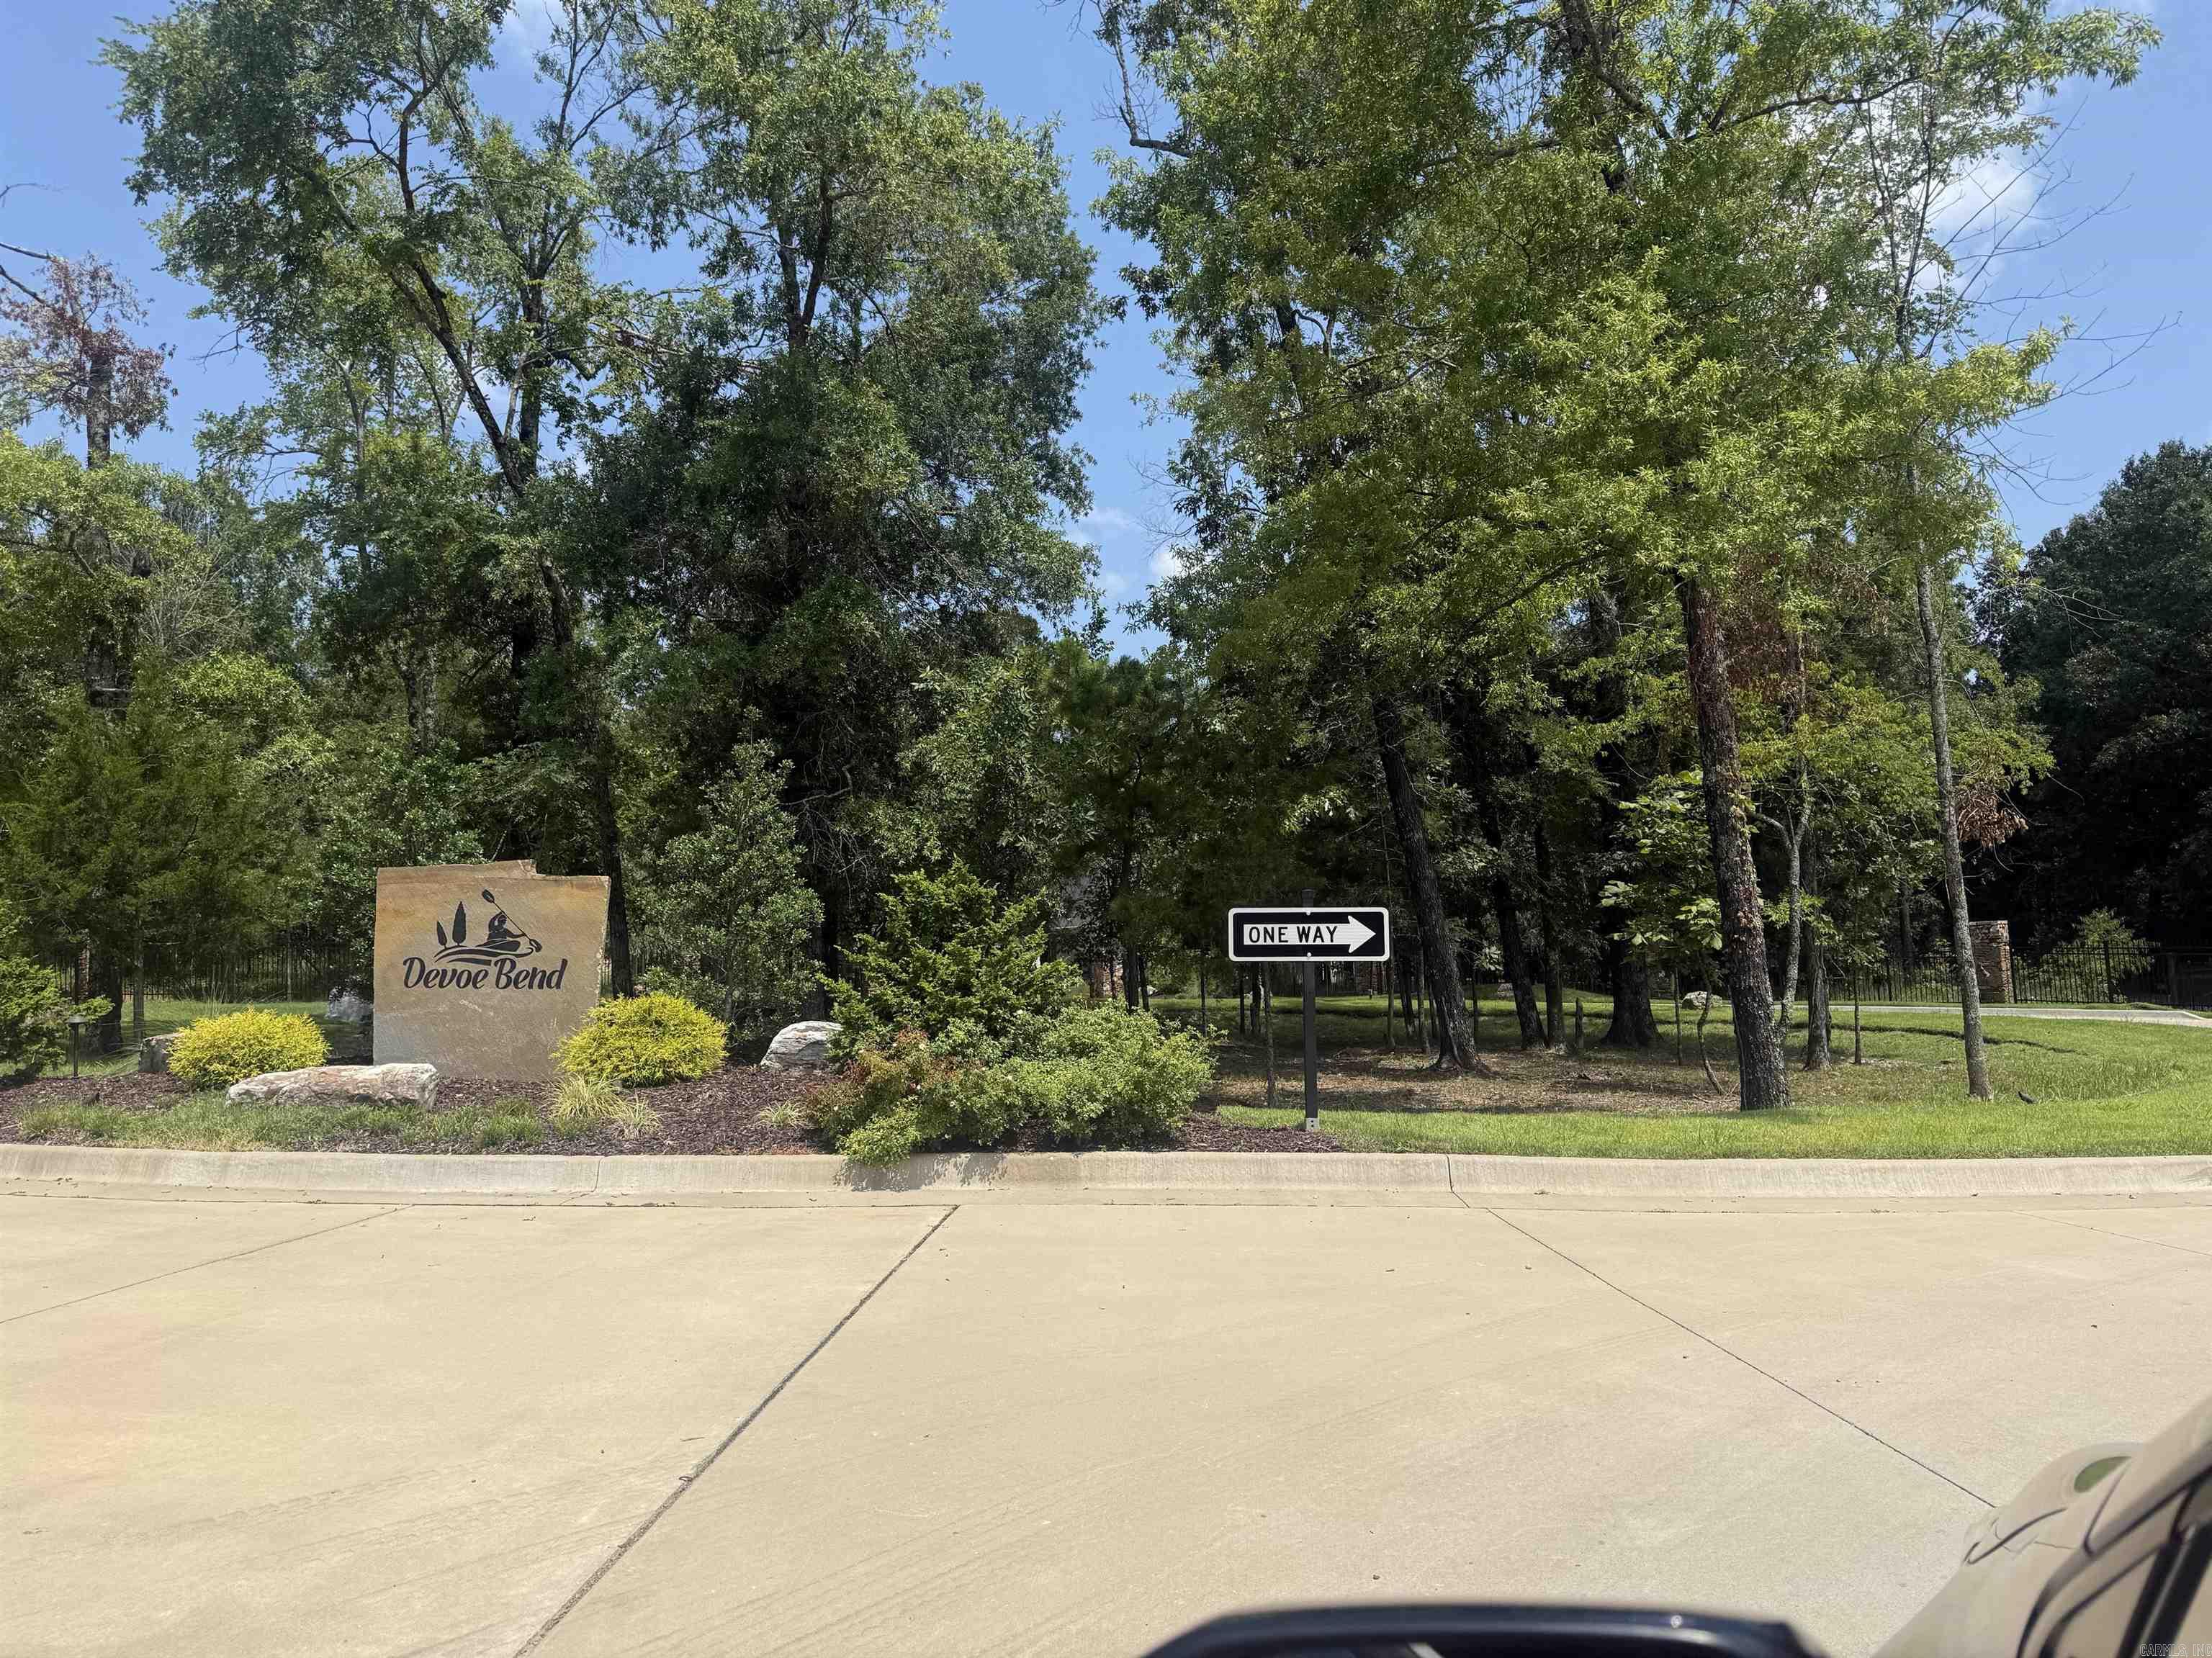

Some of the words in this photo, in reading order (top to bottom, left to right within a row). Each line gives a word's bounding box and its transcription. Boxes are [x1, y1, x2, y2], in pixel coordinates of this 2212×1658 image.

[1249, 926, 1289, 943] ONE
[1296, 926, 1338, 943] WAY
[403, 956, 490, 989] Devoe
[493, 957, 568, 990] Bend
